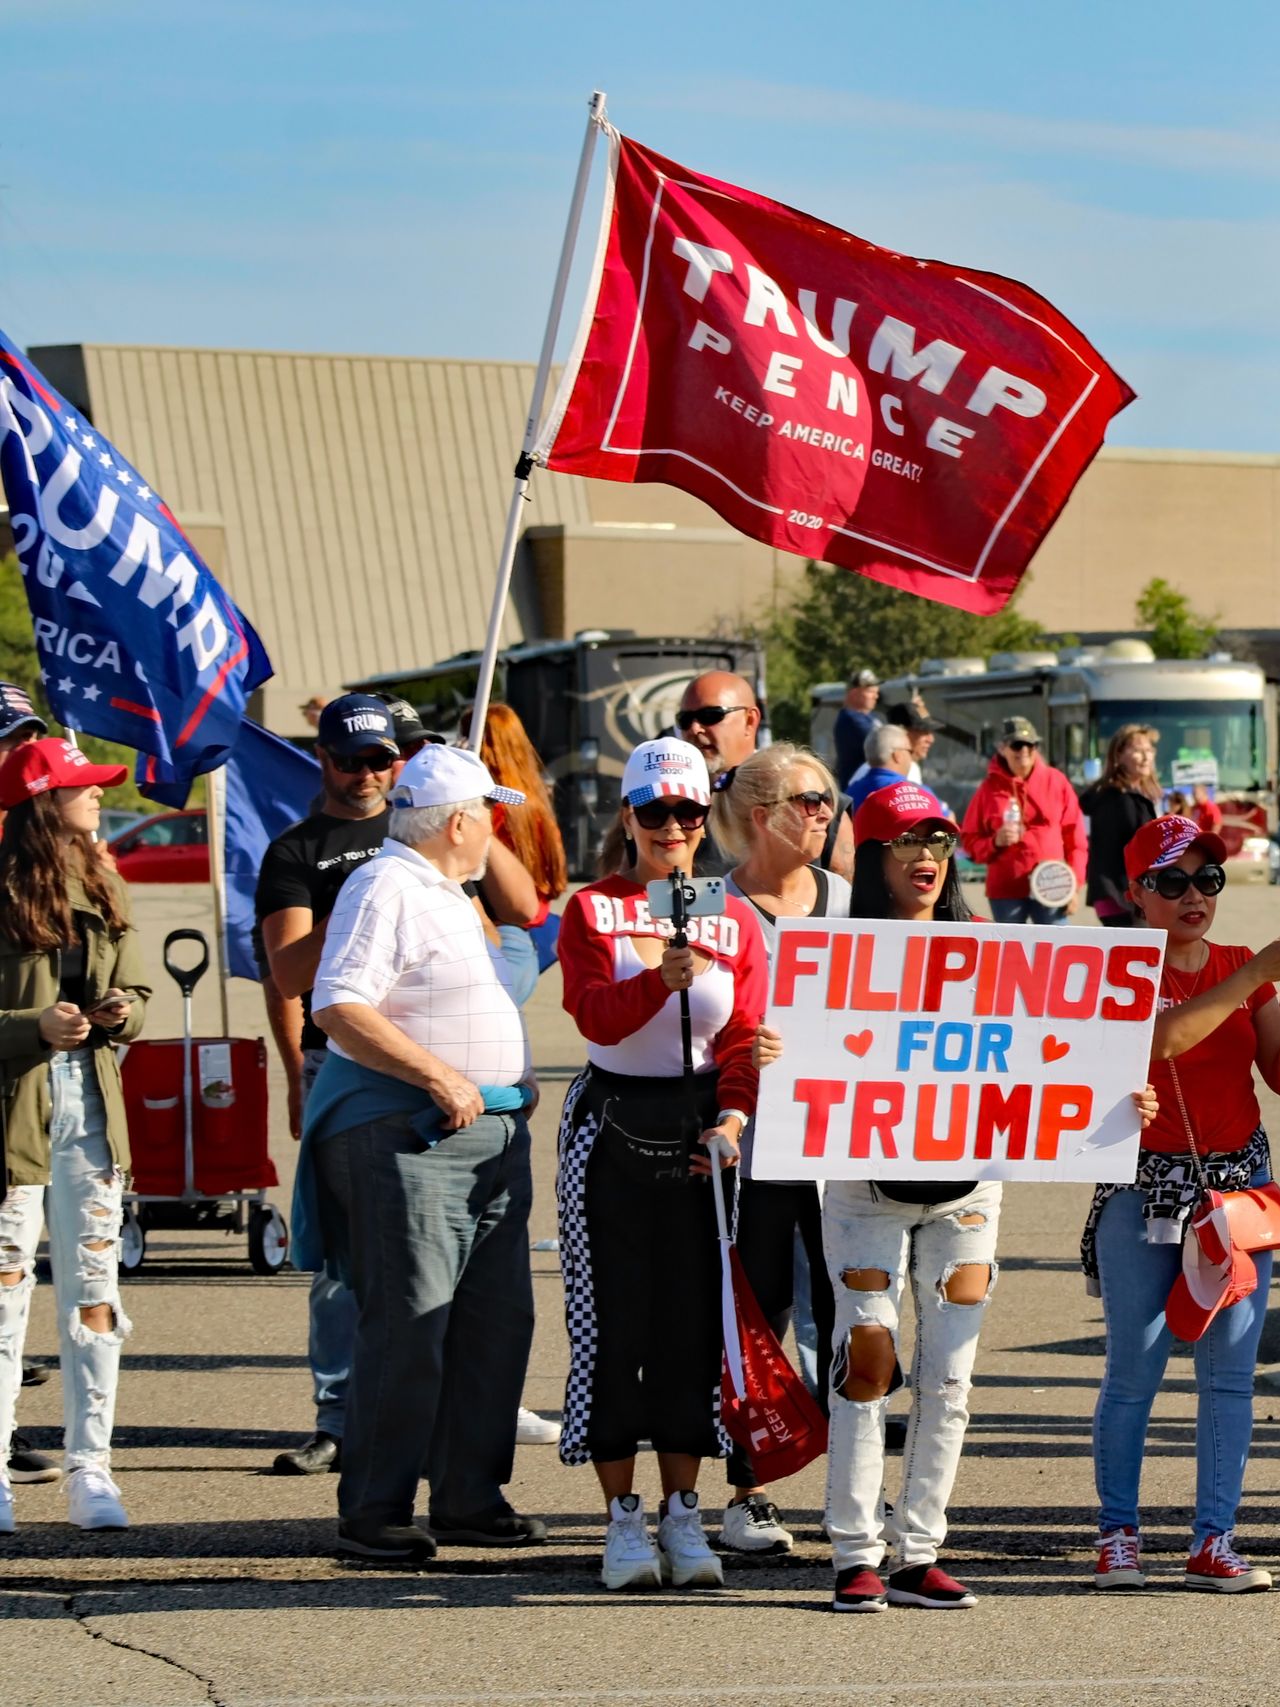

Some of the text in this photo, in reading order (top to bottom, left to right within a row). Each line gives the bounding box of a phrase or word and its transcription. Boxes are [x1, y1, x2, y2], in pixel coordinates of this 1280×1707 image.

[672, 236, 1047, 419] TRUMP
[688, 320, 975, 459] PENCE
[713, 385, 923, 483] KEEP AMERICA GREAT!
[786, 509, 823, 531] 2020
[643, 752, 693, 768] Trump
[888, 794, 931, 808] AMERICA
[896, 803, 929, 813] GREAT
[317, 856, 342, 871] ONLY
[343, 850, 366, 861] YOU
[773, 930, 1162, 1022] FILIPINOS
[896, 1020, 1013, 1073] FOR
[793, 1078, 1094, 1162] TRUMP
[763, 1407, 793, 1443] KEEP
